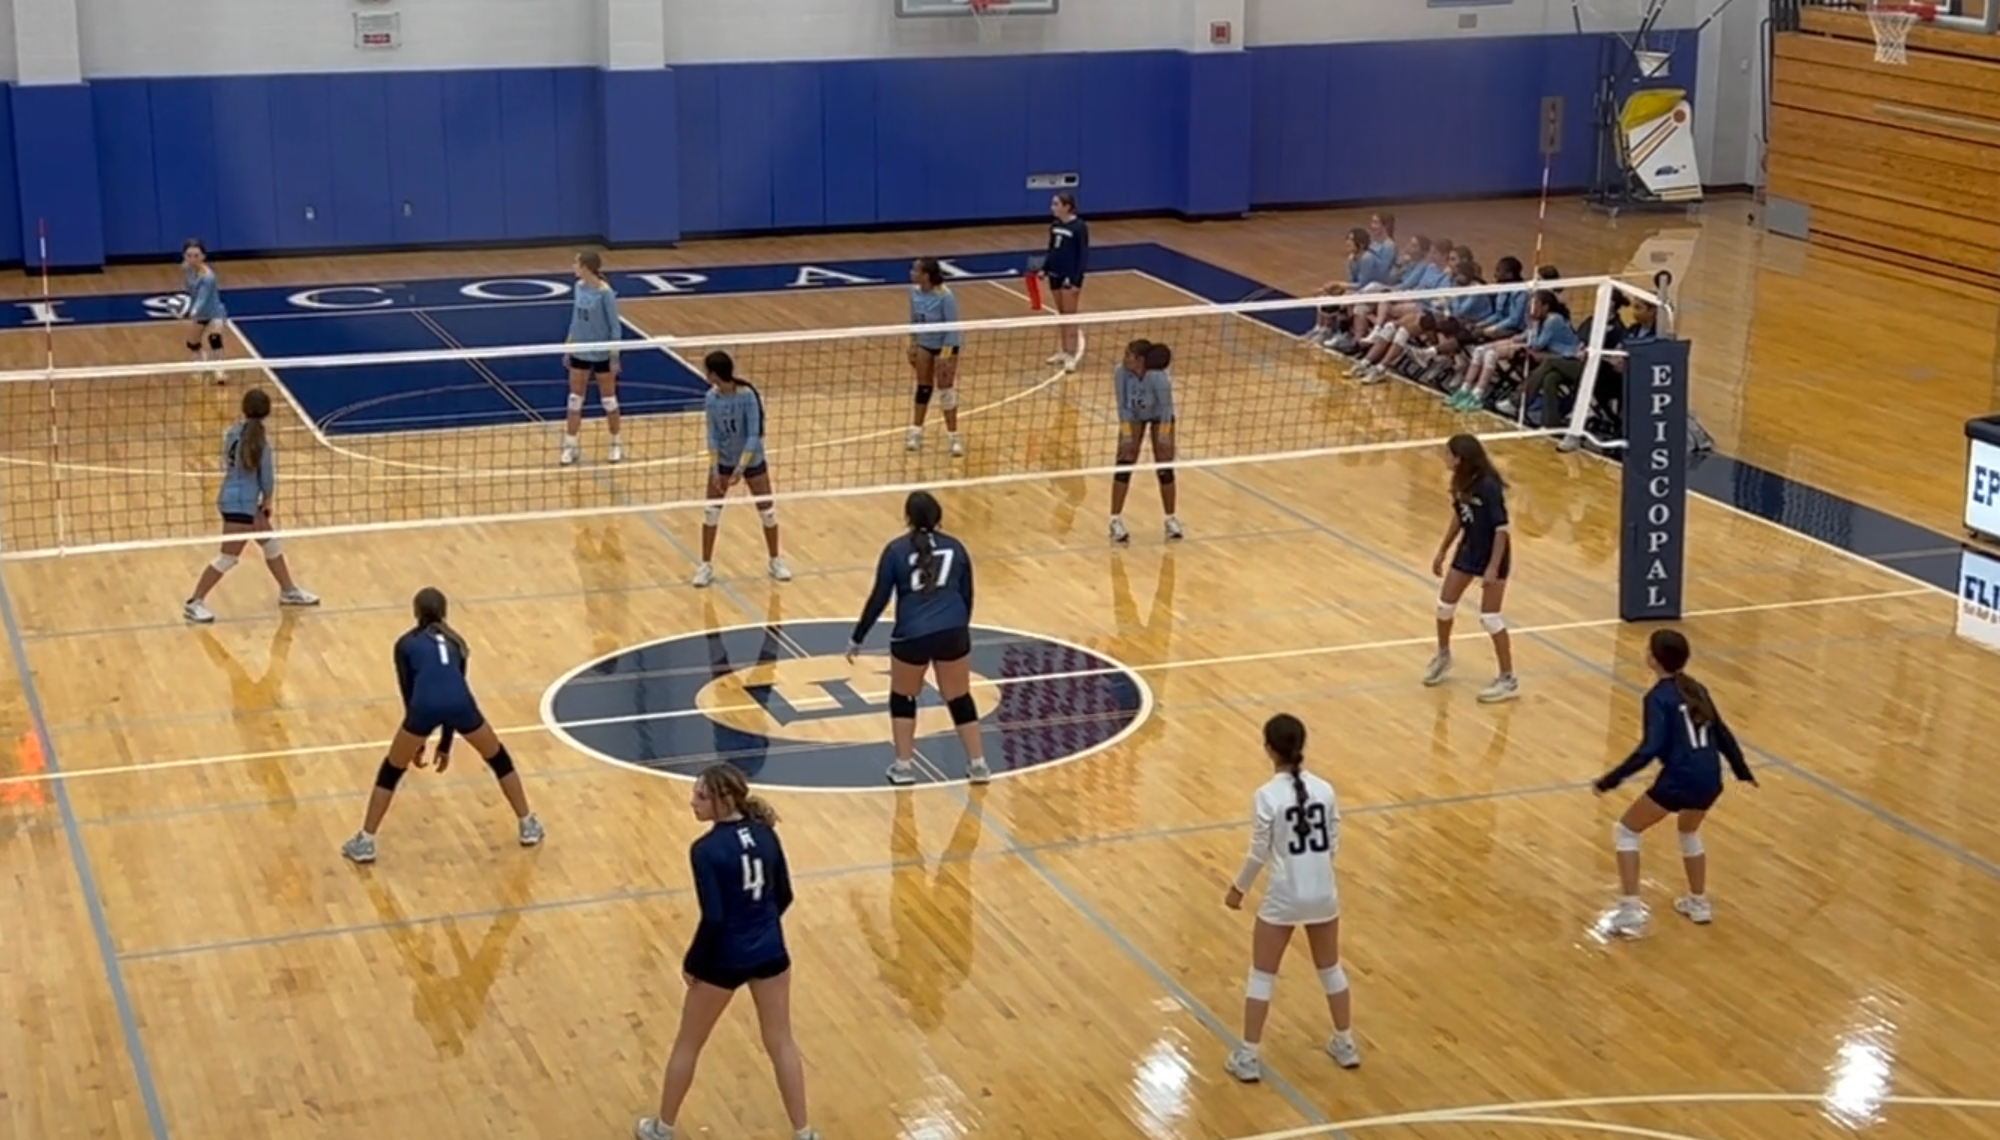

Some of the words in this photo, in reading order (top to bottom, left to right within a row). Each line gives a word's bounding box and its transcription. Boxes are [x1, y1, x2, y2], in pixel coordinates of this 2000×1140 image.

[1647, 364, 1672, 607] EPISCOPAL
[1973, 464, 2000, 507] EP
[1285, 803, 1328, 854] 33
[741, 854, 765, 901] 4
